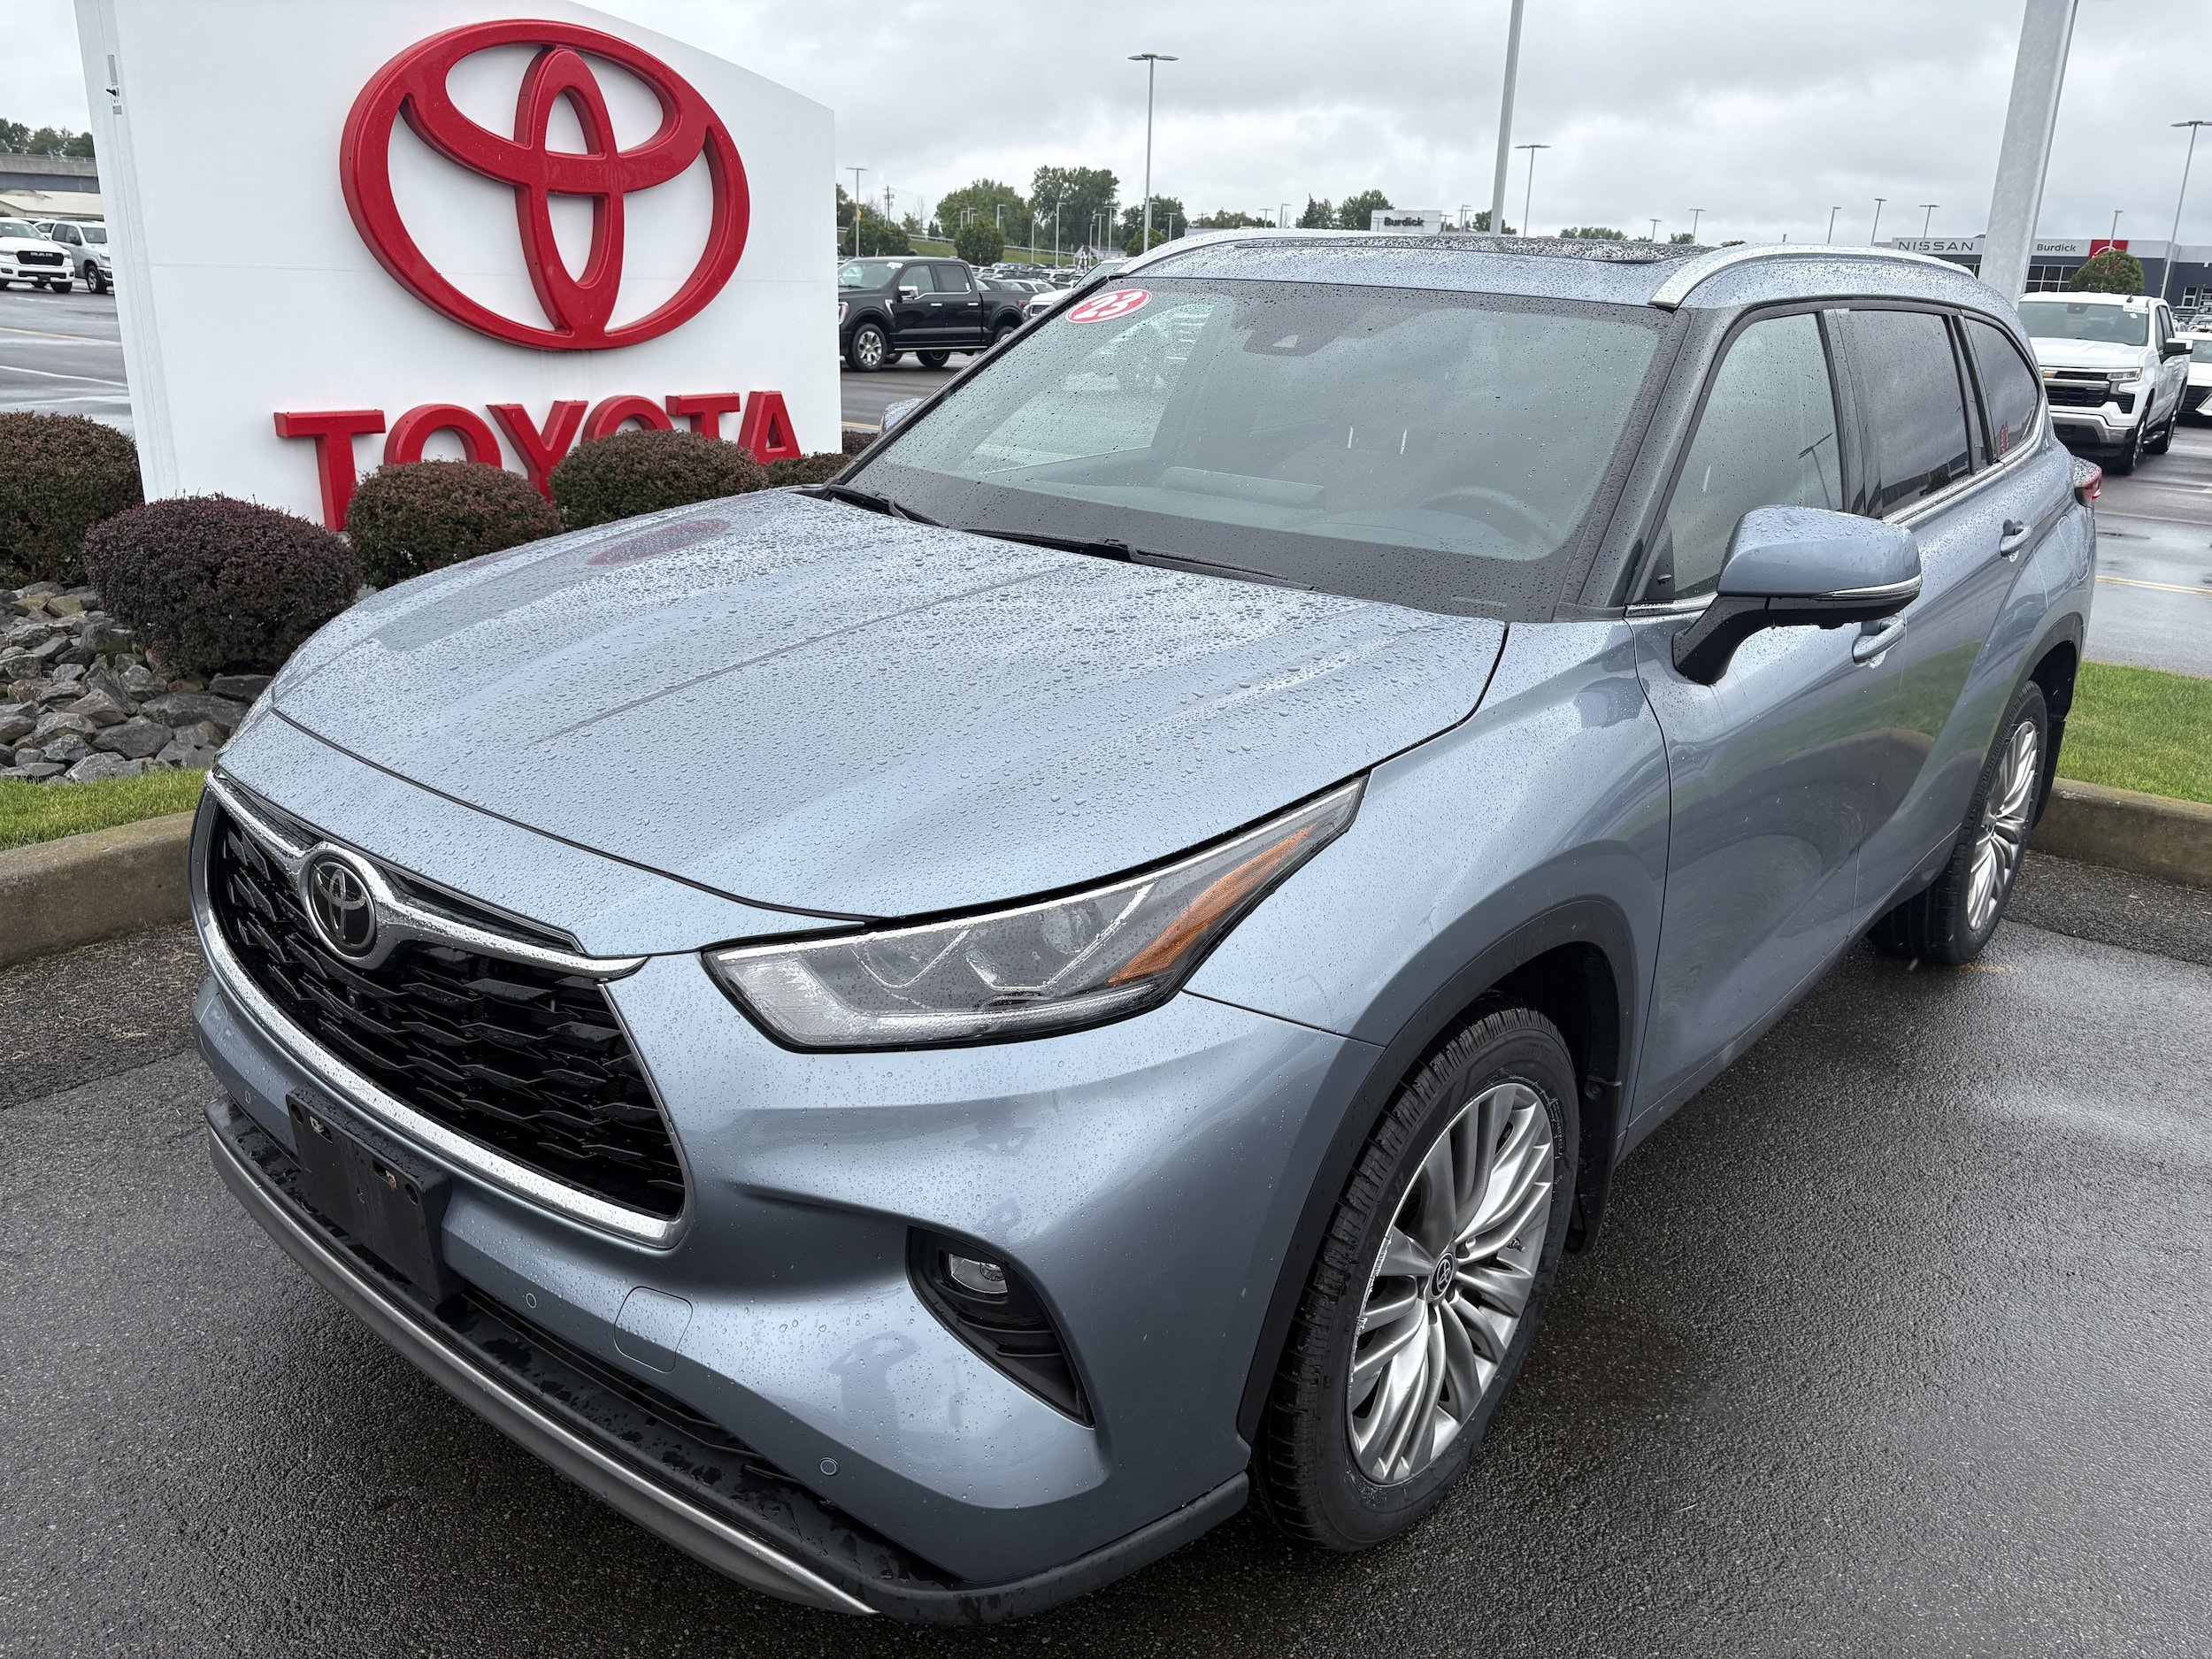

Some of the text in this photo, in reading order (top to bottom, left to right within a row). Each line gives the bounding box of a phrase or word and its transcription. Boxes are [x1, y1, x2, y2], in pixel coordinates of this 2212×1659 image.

[1384, 217, 1425, 227] Burdick
[1898, 241, 1974, 251] NISSAN
[2037, 243, 2078, 252] Burdick
[1072, 291, 1144, 319] 23
